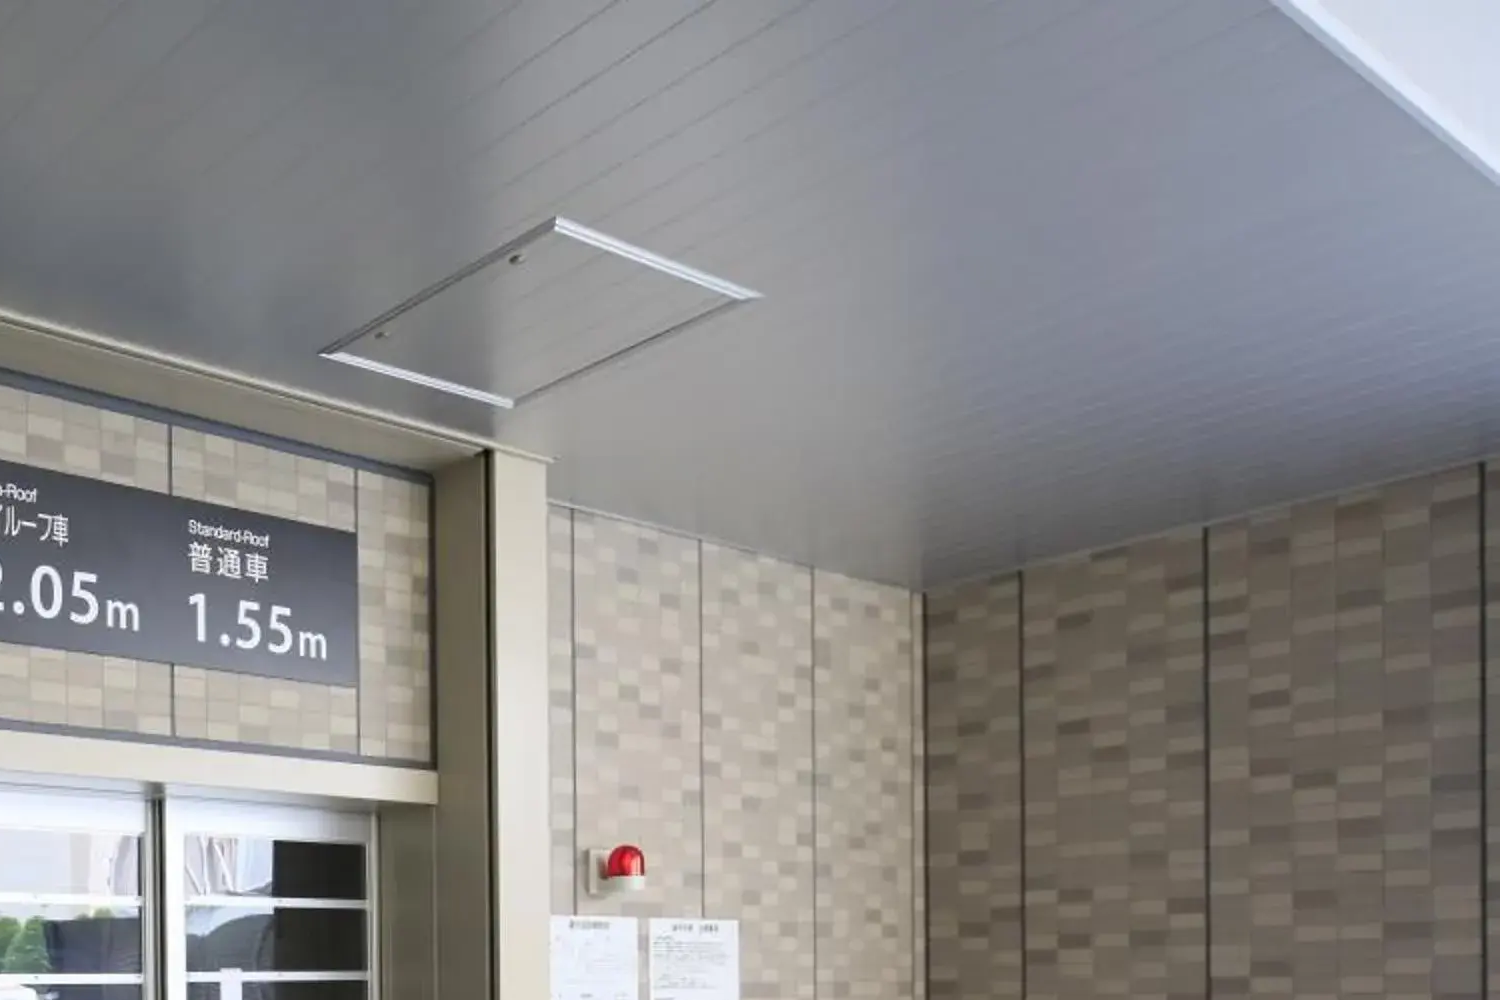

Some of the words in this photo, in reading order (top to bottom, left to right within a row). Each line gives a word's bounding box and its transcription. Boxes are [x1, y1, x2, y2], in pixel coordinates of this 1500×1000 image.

[187, 518, 270, 549] Standard-Roof
[187, 541, 270, 583] 普通車
[188, 592, 328, 661] 1.55m
